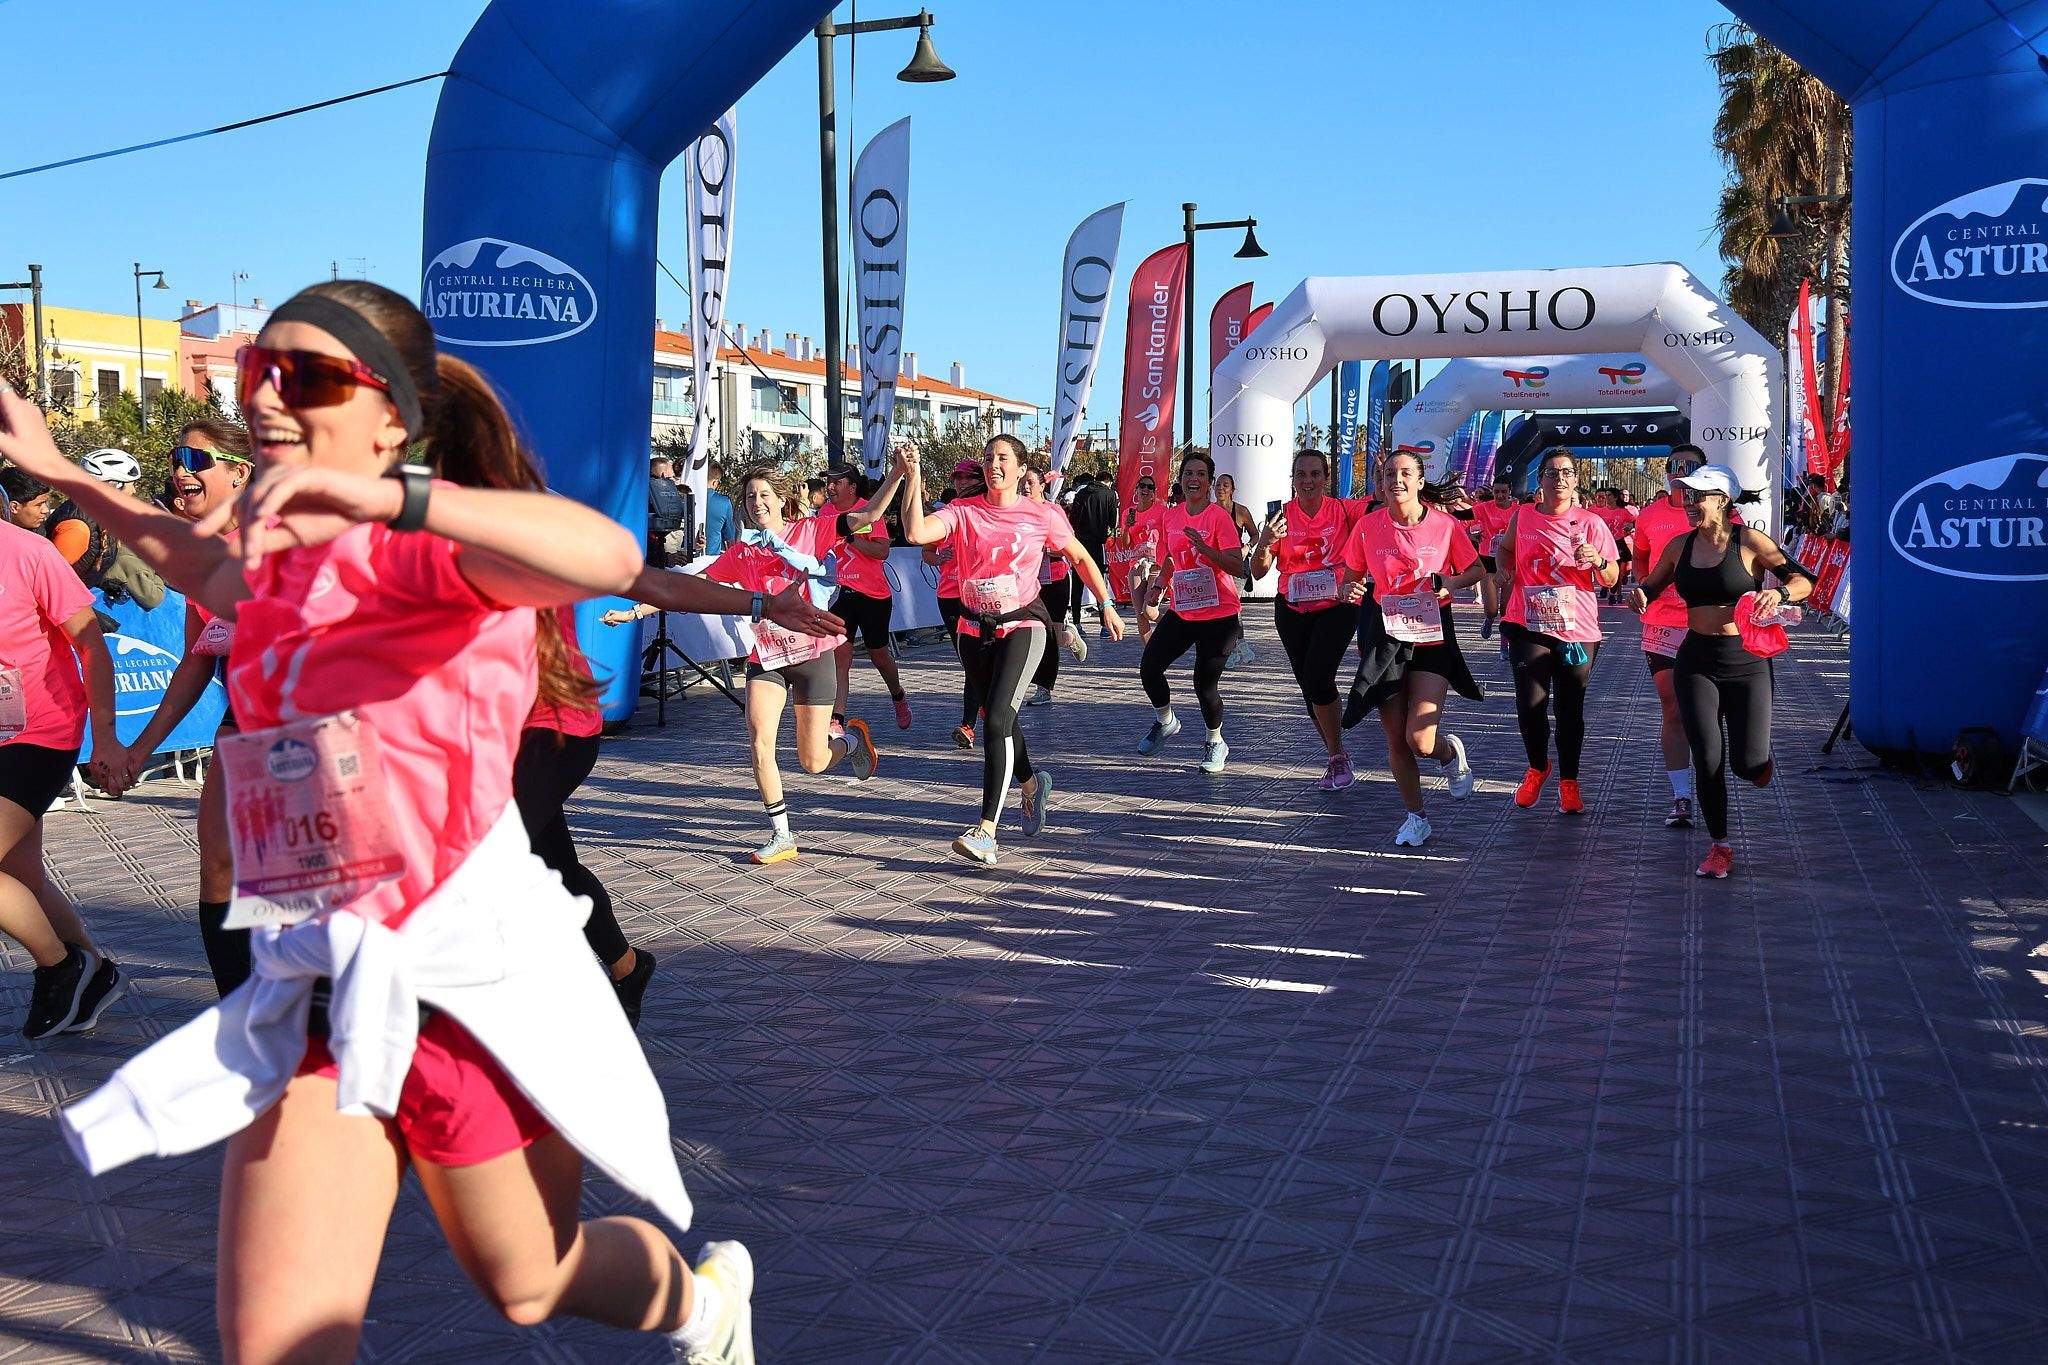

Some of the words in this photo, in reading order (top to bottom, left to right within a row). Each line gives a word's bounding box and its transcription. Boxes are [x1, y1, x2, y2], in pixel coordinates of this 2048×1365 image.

[1947, 223, 2040, 241] CENTRAL
[439, 275, 495, 286] CENTRAL
[502, 276, 576, 291] LECHERA
[425, 279, 581, 323] ASTURIANA
[1372, 286, 1596, 337] OYSHO
[1143, 281, 1169, 399] Santander
[1664, 331, 1735, 348] OYSHO
[1246, 347, 1308, 361] OYSHO
[1502, 391, 1550, 399] TotalEnergies
[1598, 388, 1647, 396] TotalEnergies
[1341, 389, 1357, 455] Marlene
[1556, 424, 1658, 435] VOLVO
[1702, 425, 1768, 442] OYSHO
[1216, 433, 1274, 448] OYSHO
[1944, 498, 2035, 511] CENTRAL
[1187, 585, 1204, 595] 016
[1307, 583, 1327, 592] 016
[981, 600, 1002, 611] 016
[1541, 606, 1560, 615] 016
[1401, 614, 1424, 625] 016
[1652, 626, 1671, 638] 016
[775, 635, 796, 647] 016
[125, 659, 169, 669] LECHERA
[285, 812, 338, 848] 016
